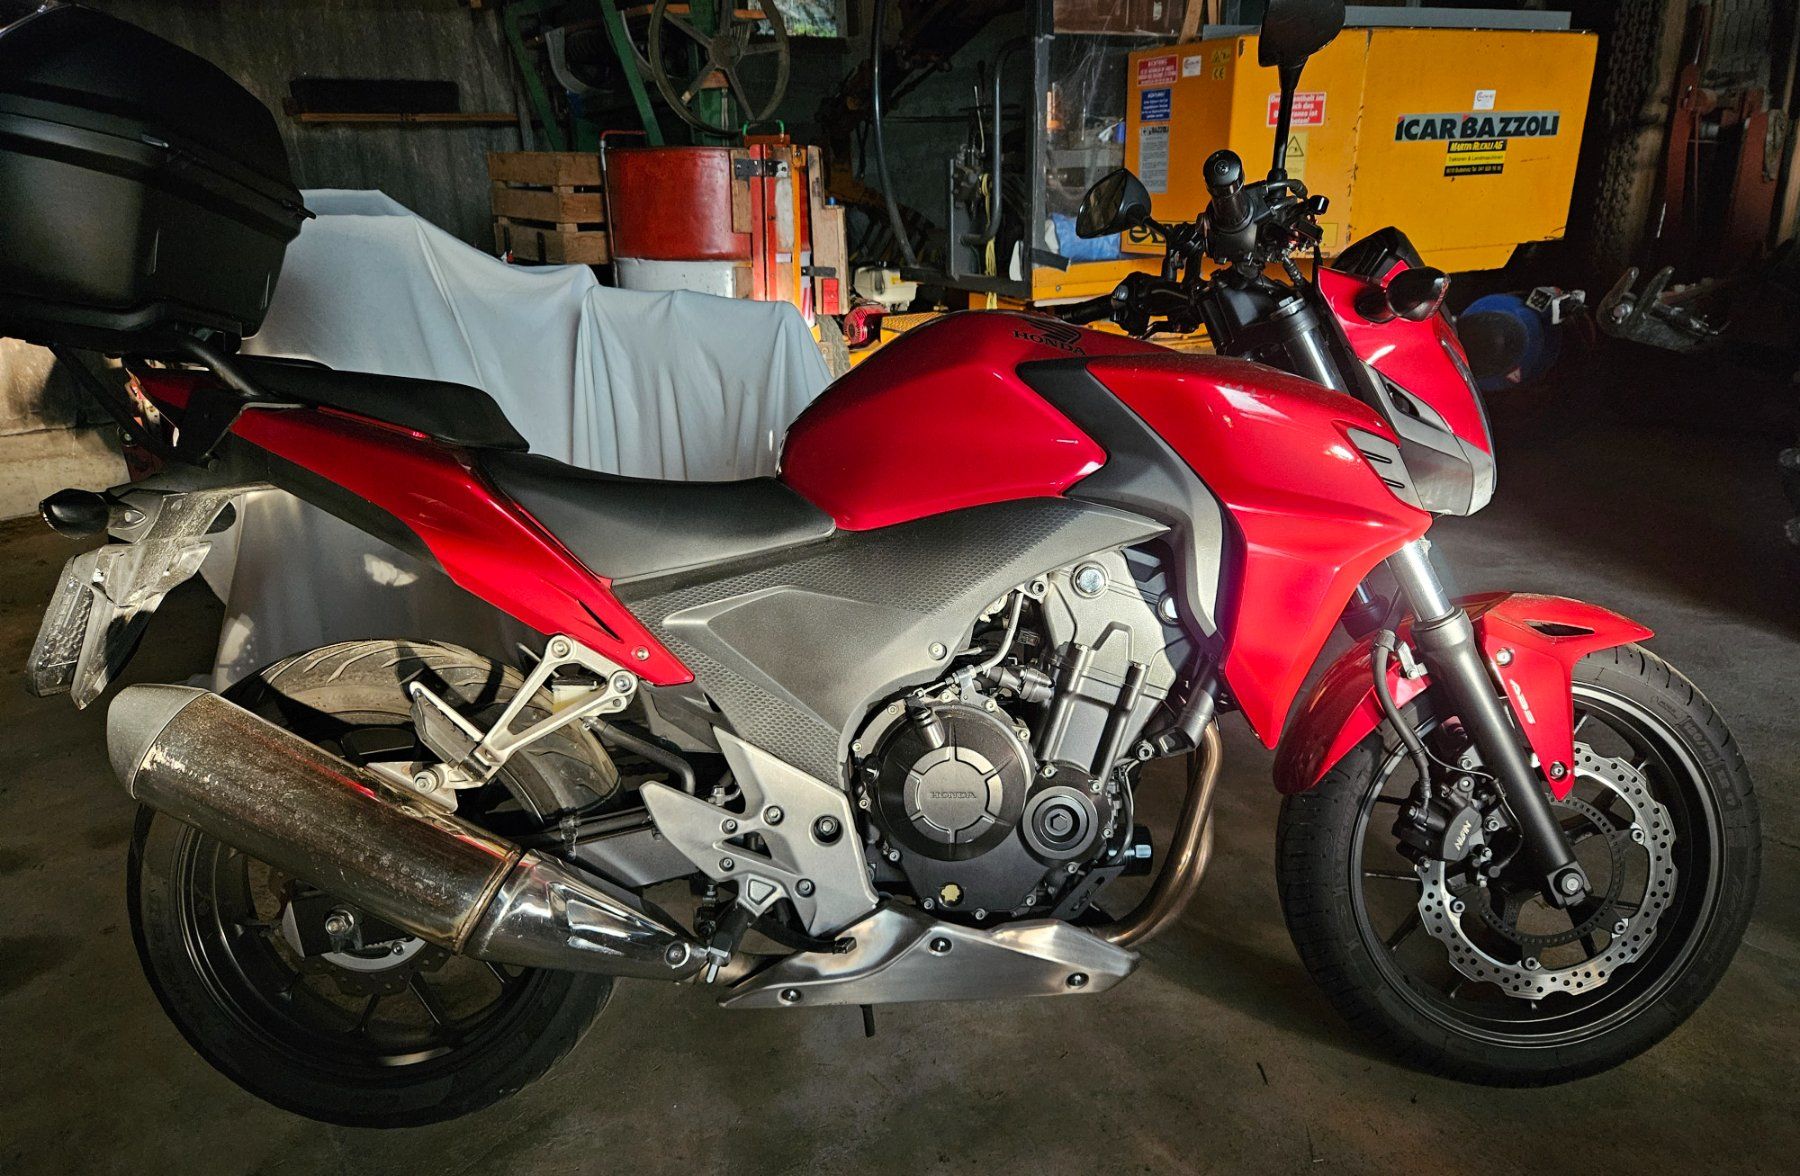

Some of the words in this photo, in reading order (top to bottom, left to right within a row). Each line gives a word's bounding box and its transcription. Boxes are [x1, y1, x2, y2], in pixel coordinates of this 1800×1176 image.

[1460, 114, 1560, 138] BAZZOLI
[1014, 329, 1088, 358] HONDA
[929, 791, 977, 799] HONDA
